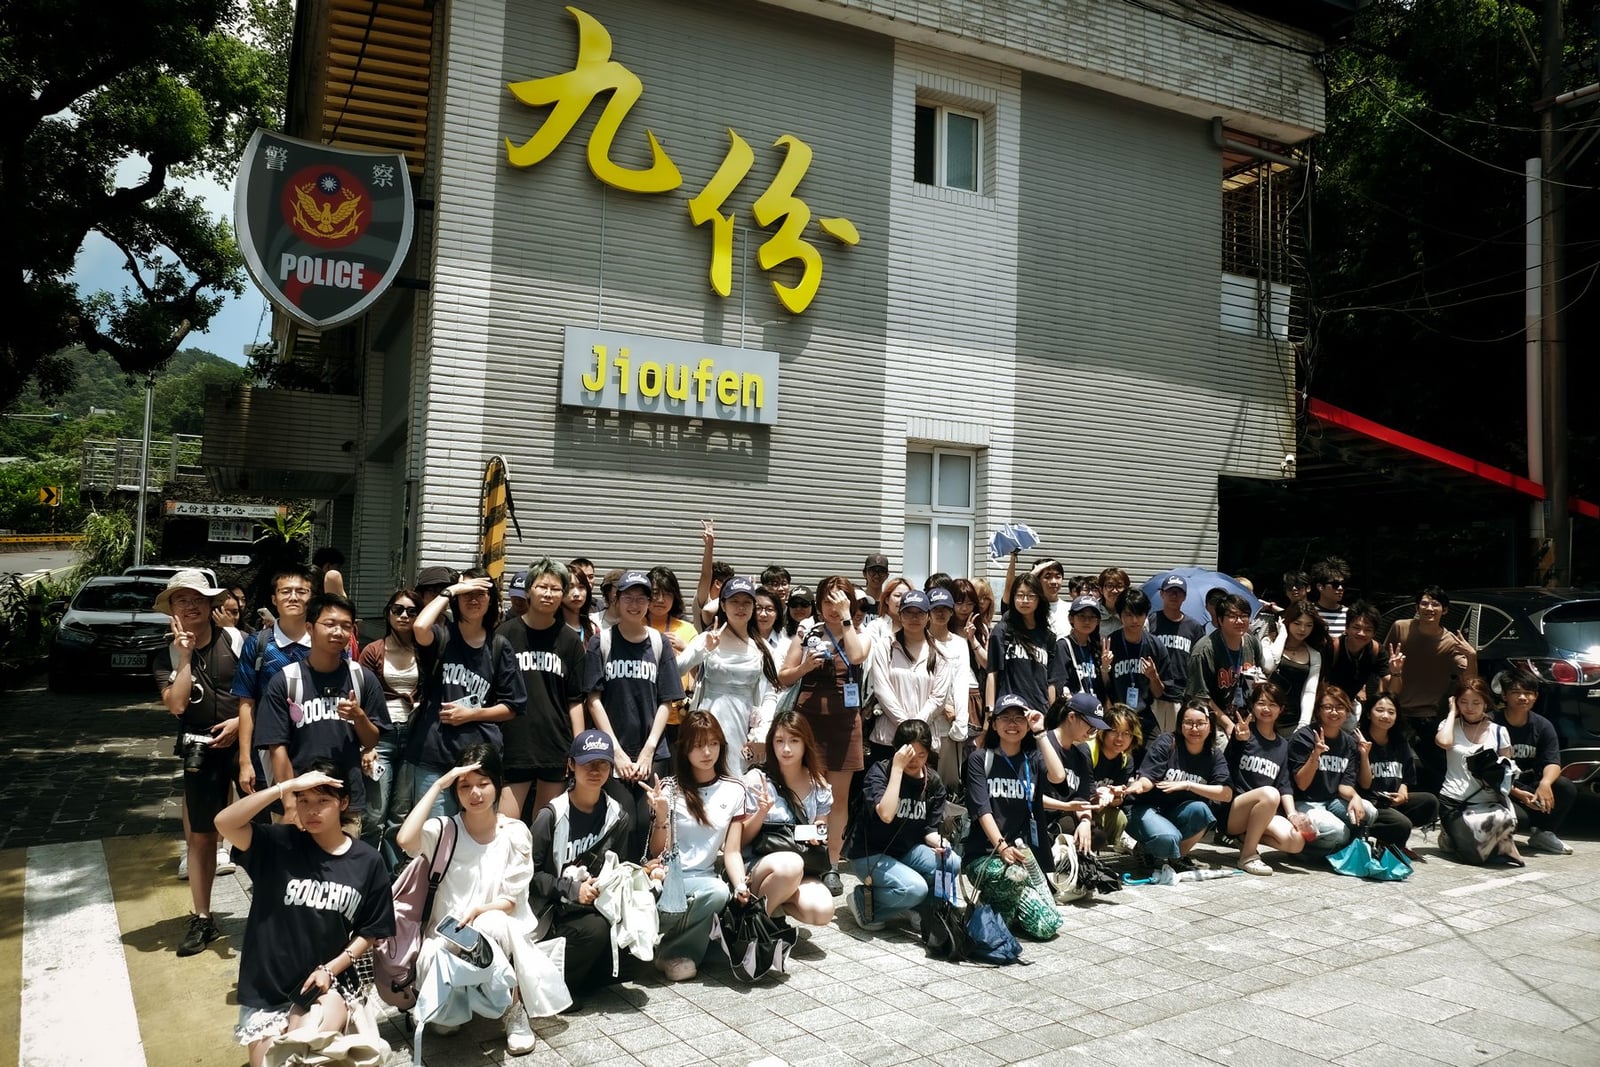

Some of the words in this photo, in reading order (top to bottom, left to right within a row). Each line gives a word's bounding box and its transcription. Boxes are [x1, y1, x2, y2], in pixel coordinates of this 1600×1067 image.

[265, 146, 289, 172] 警
[371, 163, 395, 188] 察
[505, 6, 860, 314] 九份
[280, 252, 366, 290] POLICE
[582, 344, 765, 408] Jioufen
[1114, 658, 1142, 678] SOOCH
